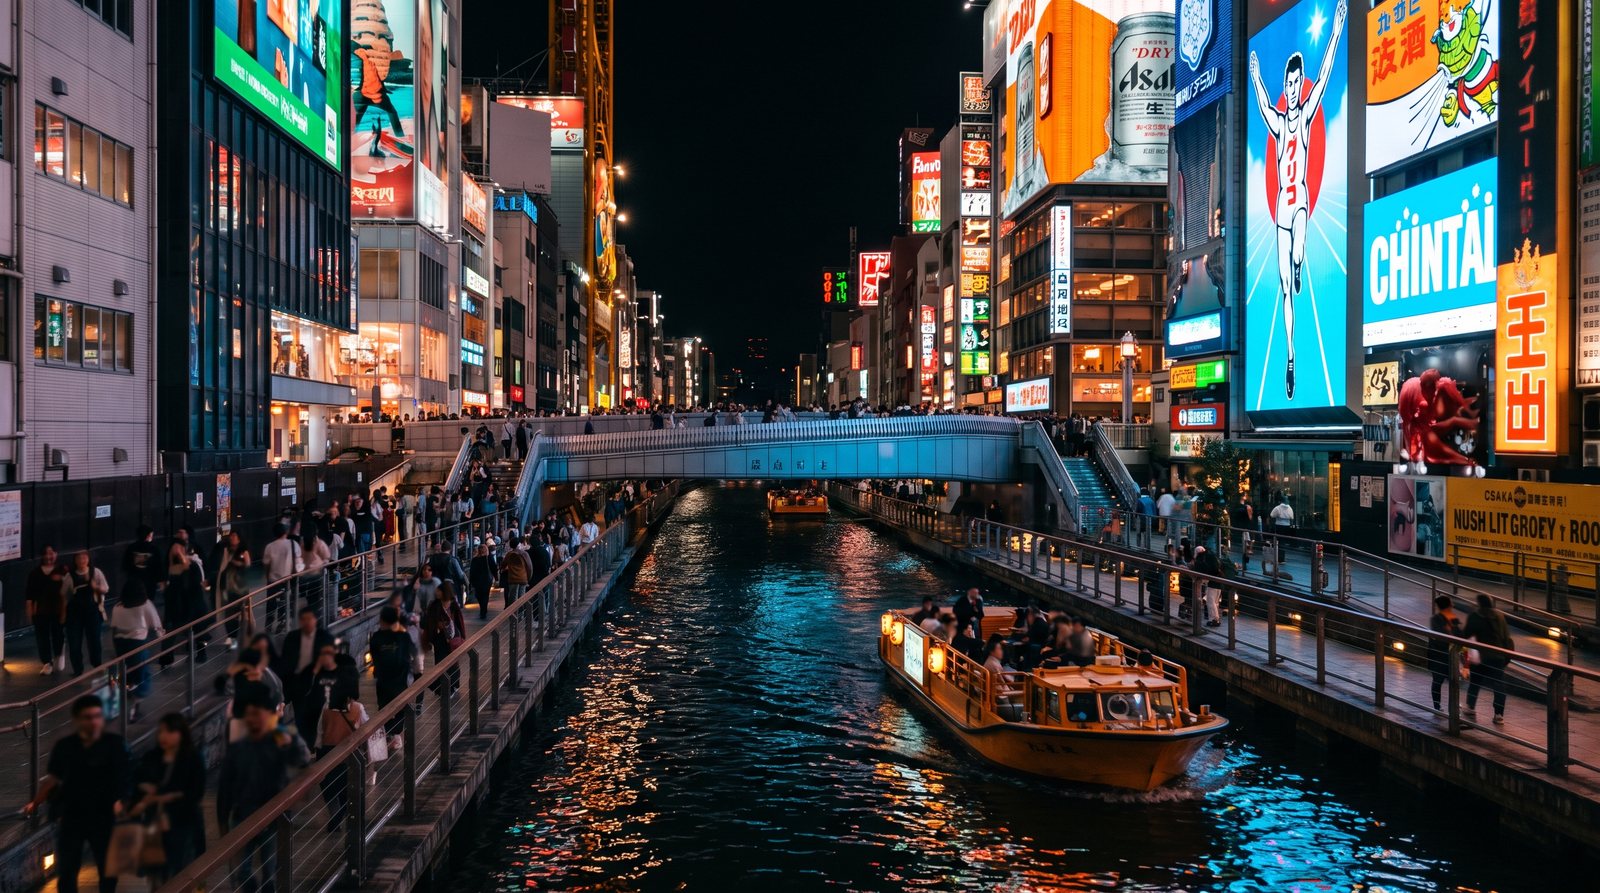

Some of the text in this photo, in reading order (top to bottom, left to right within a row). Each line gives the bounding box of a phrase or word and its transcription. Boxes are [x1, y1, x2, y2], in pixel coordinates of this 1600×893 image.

[1146, 102, 1164, 115] 生
[1286, 134, 1297, 206] グリコ
[1454, 508, 1486, 533] NUSH
